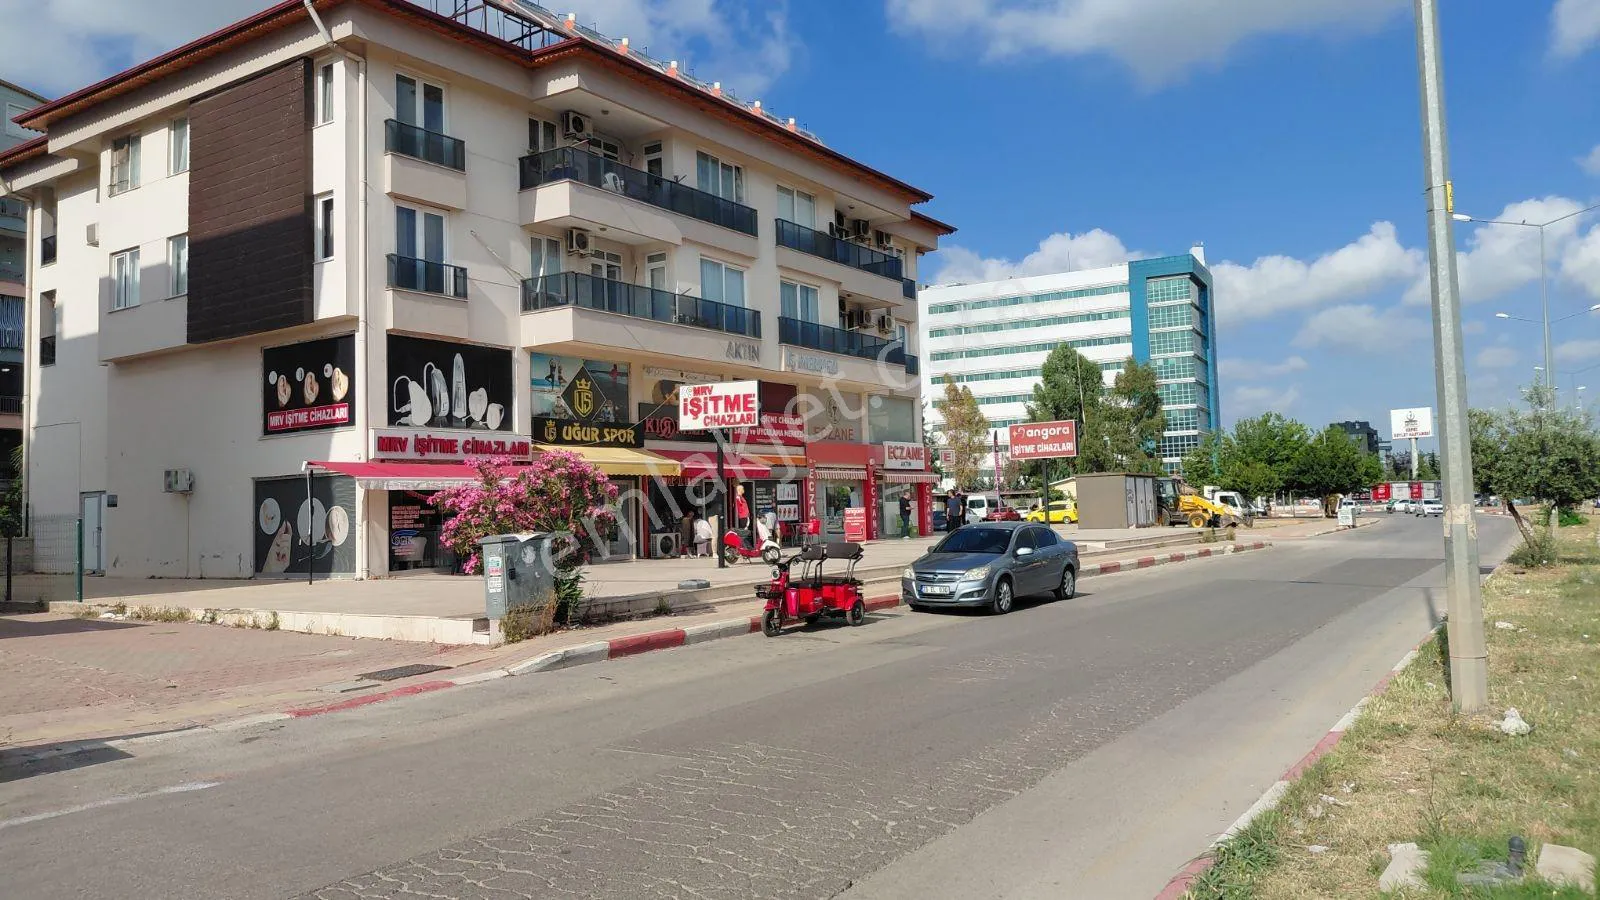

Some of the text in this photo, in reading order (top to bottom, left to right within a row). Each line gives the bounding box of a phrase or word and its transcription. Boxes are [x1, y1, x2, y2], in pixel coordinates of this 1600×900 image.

[693, 385, 714, 397] MRV
[683, 393, 756, 420] İŞİTME
[270, 412, 285, 427] MRV
[560, 419, 600, 442] UĞUR
[603, 427, 636, 445] SPOR
[1026, 426, 1070, 440] angora
[376, 435, 409, 453] MRV
[413, 434, 459, 457] İŞİTME
[887, 444, 925, 461] ECZANE
[809, 471, 817, 517] ECZA
[924, 482, 932, 533] CZANE
